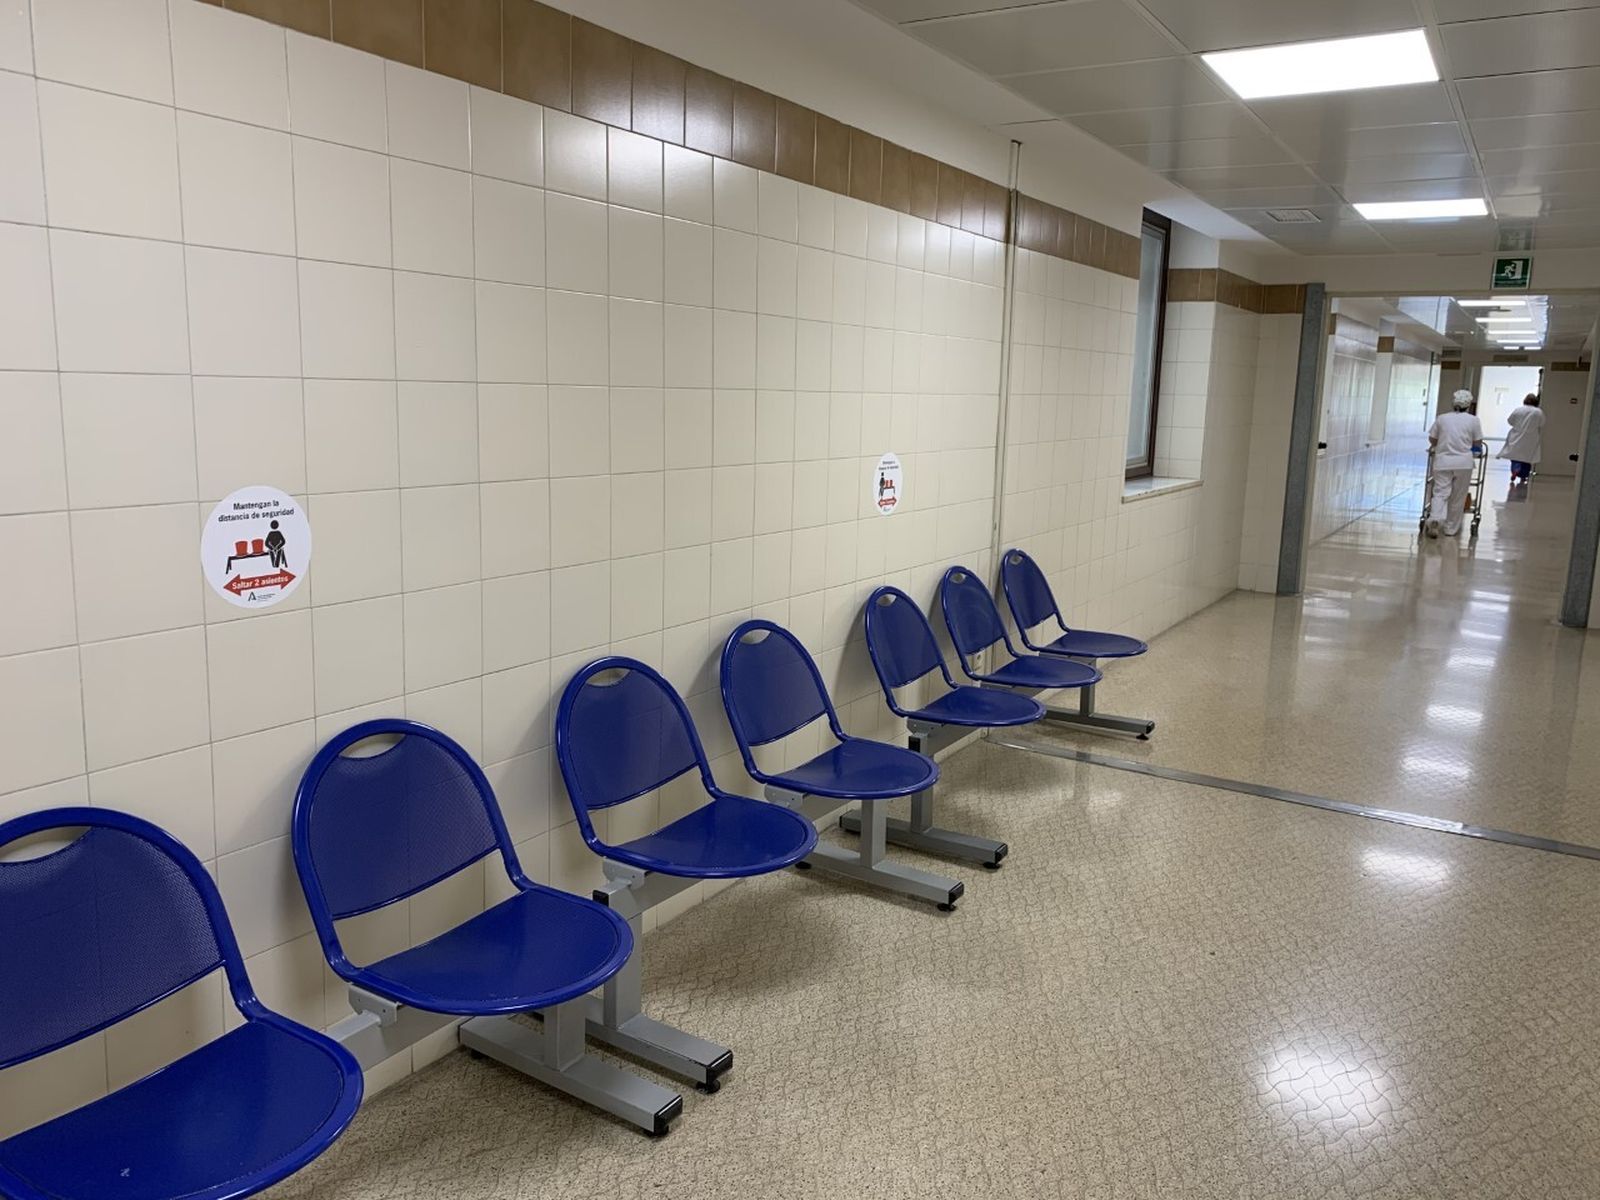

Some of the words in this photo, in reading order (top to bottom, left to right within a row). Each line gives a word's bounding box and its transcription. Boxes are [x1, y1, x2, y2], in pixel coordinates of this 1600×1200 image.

[233, 501, 271, 510] Mantengan
[218, 512, 250, 522] distancia
[251, 511, 260, 519] de
[262, 508, 295, 519] seguridad
[232, 581, 253, 590] Saltar
[254, 578, 260, 587] 2
